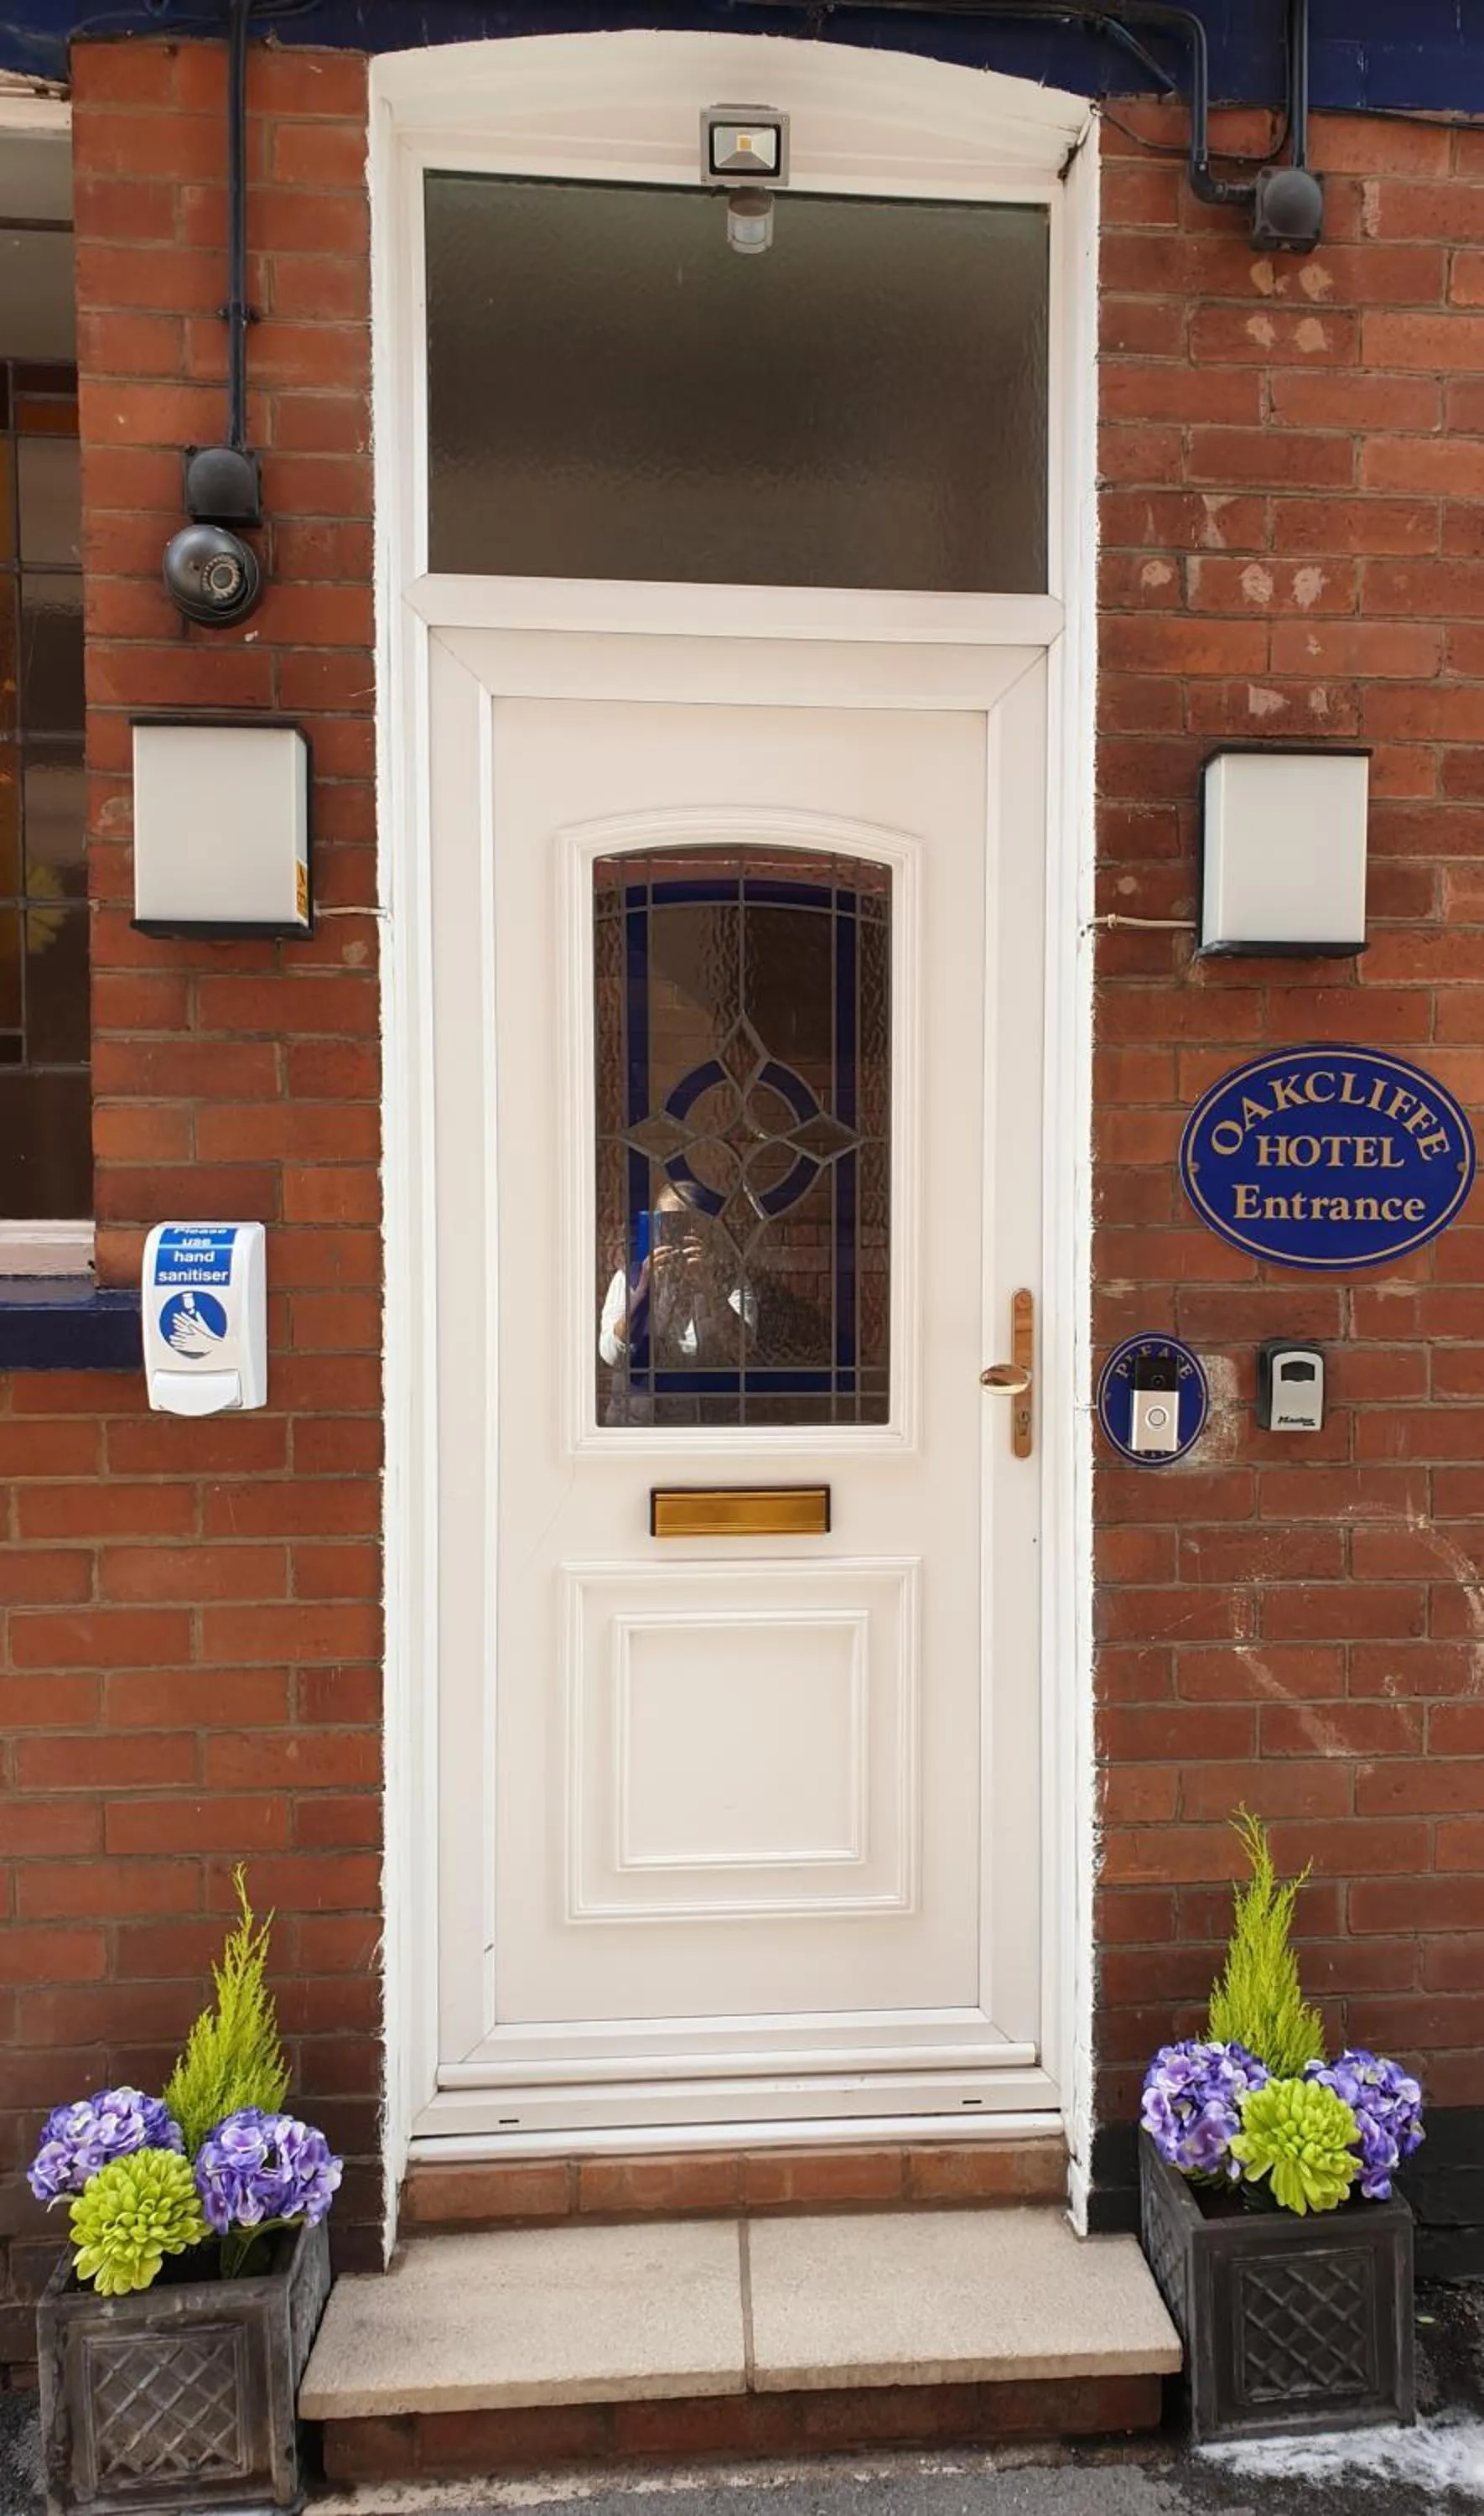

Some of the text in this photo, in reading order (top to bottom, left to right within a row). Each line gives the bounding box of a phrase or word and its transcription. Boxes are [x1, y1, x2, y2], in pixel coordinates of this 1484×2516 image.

[1211, 1070, 1450, 1162] OAKCLIFFE
[1254, 1135, 1405, 1168] HOTEL
[1232, 1183, 1426, 1222] Entrance
[174, 1250, 215, 1262] hand
[158, 1268, 229, 1282] sanitiser
